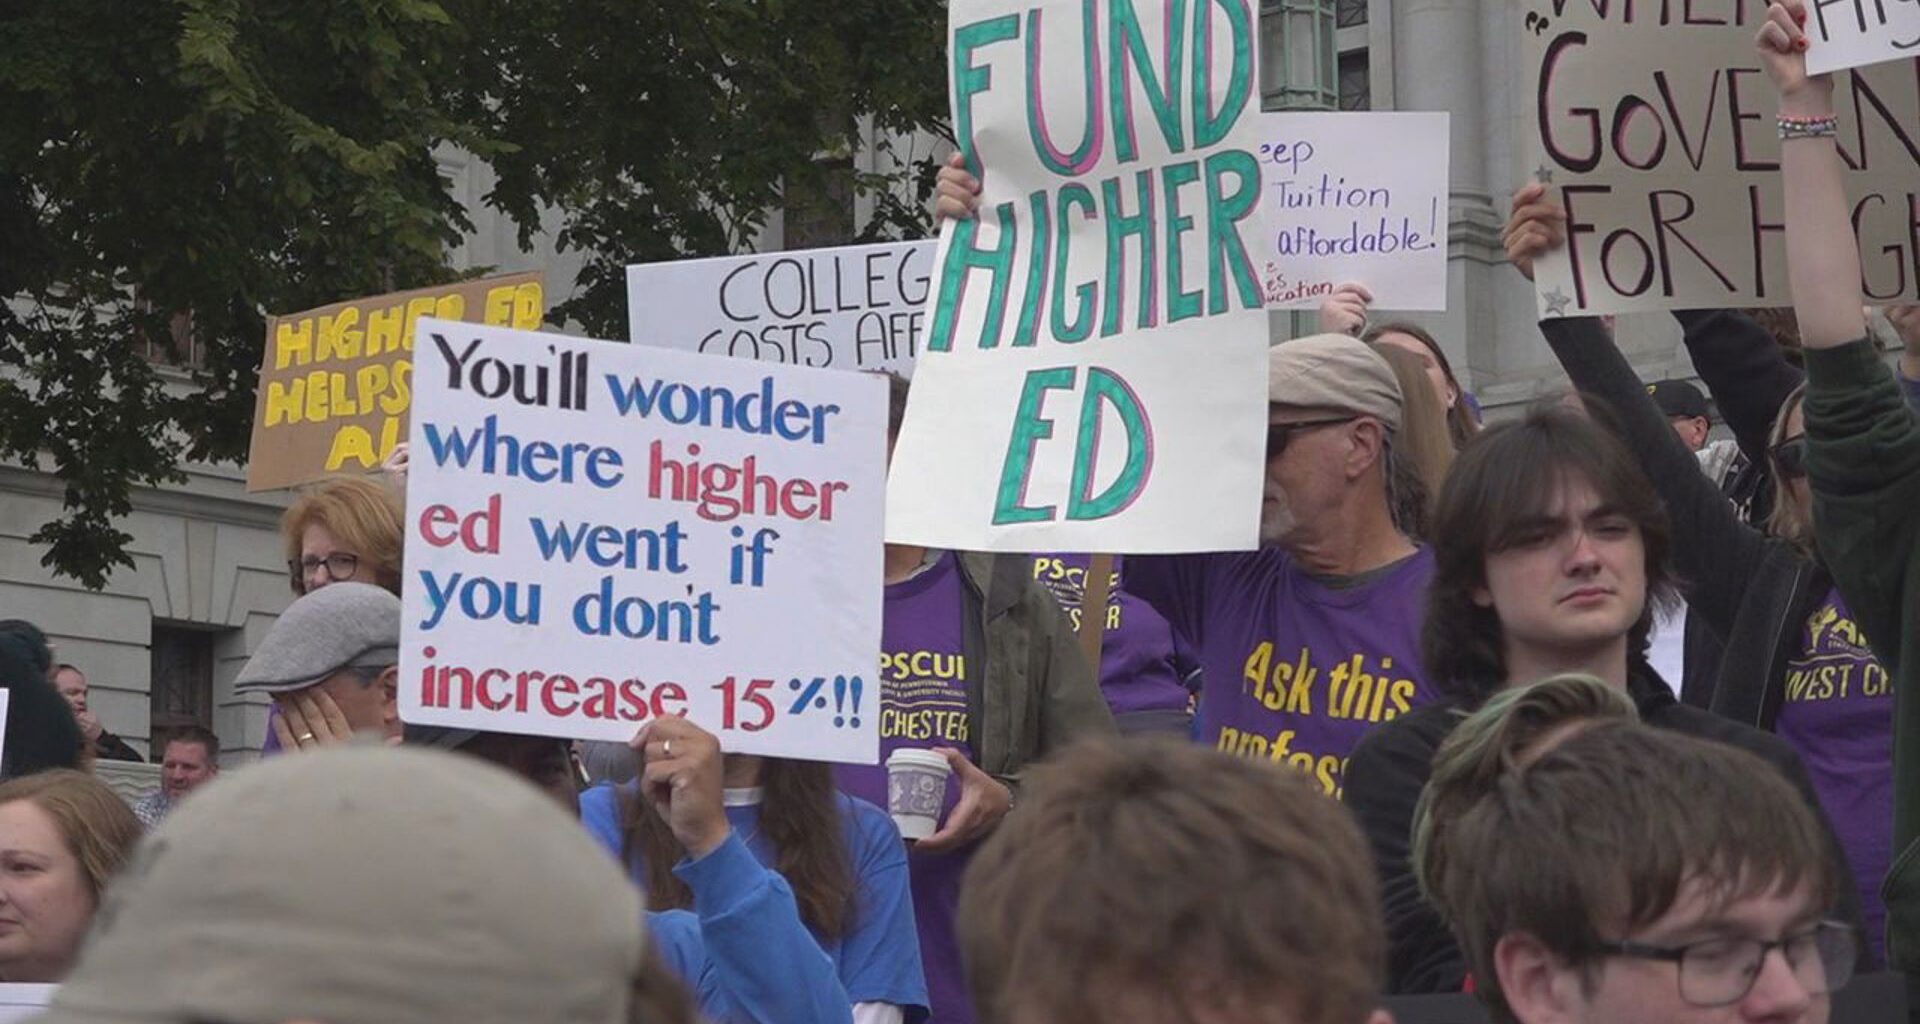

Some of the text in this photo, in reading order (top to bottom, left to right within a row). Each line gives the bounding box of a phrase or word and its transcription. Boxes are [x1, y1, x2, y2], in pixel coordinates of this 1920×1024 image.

[954, 0, 1255, 179] FUND
[1272, 173, 1390, 209] Tuition
[1278, 196, 1437, 257] affordable!
[719, 247, 931, 322] COLLEG
[927, 150, 1265, 352] HIGHER
[856, 311, 925, 366] AFF
[264, 359, 413, 427] HELPS
[430, 333, 840, 444] You'll wonder
[423, 414, 850, 522] where higher
[991, 366, 1154, 526] ED
[418, 493, 780, 587] ed went if
[418, 569, 721, 646] you don't
[420, 646, 688, 723] increase
[1242, 641, 1415, 723] Ask this
[1784, 663, 1855, 702] WEST
